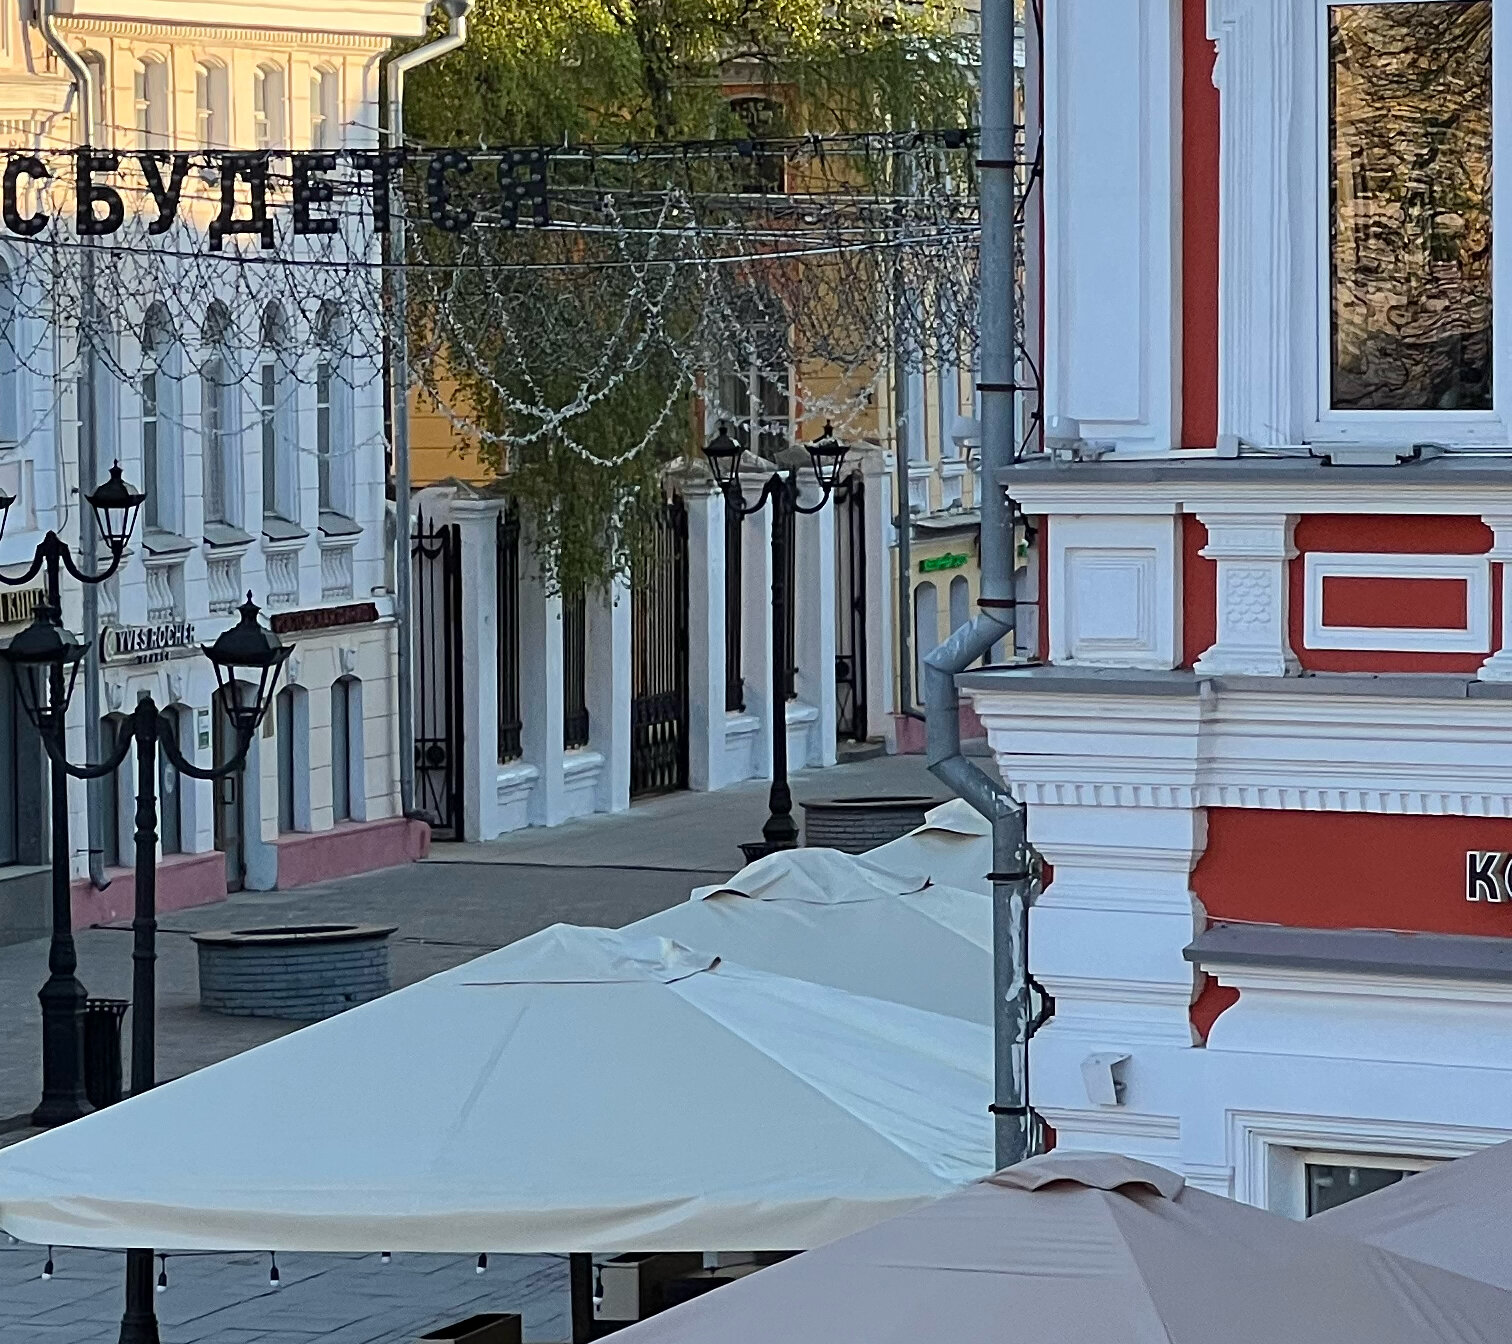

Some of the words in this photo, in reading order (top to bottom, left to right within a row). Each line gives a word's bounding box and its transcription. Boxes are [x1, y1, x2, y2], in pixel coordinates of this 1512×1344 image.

[2, 152, 549, 251] СБУДЕТСЯ
[7, 588, 42, 623] КНИГ
[117, 629, 148, 651] YVES
[149, 624, 195, 647] ROCHER
[1466, 850, 1512, 904] К
